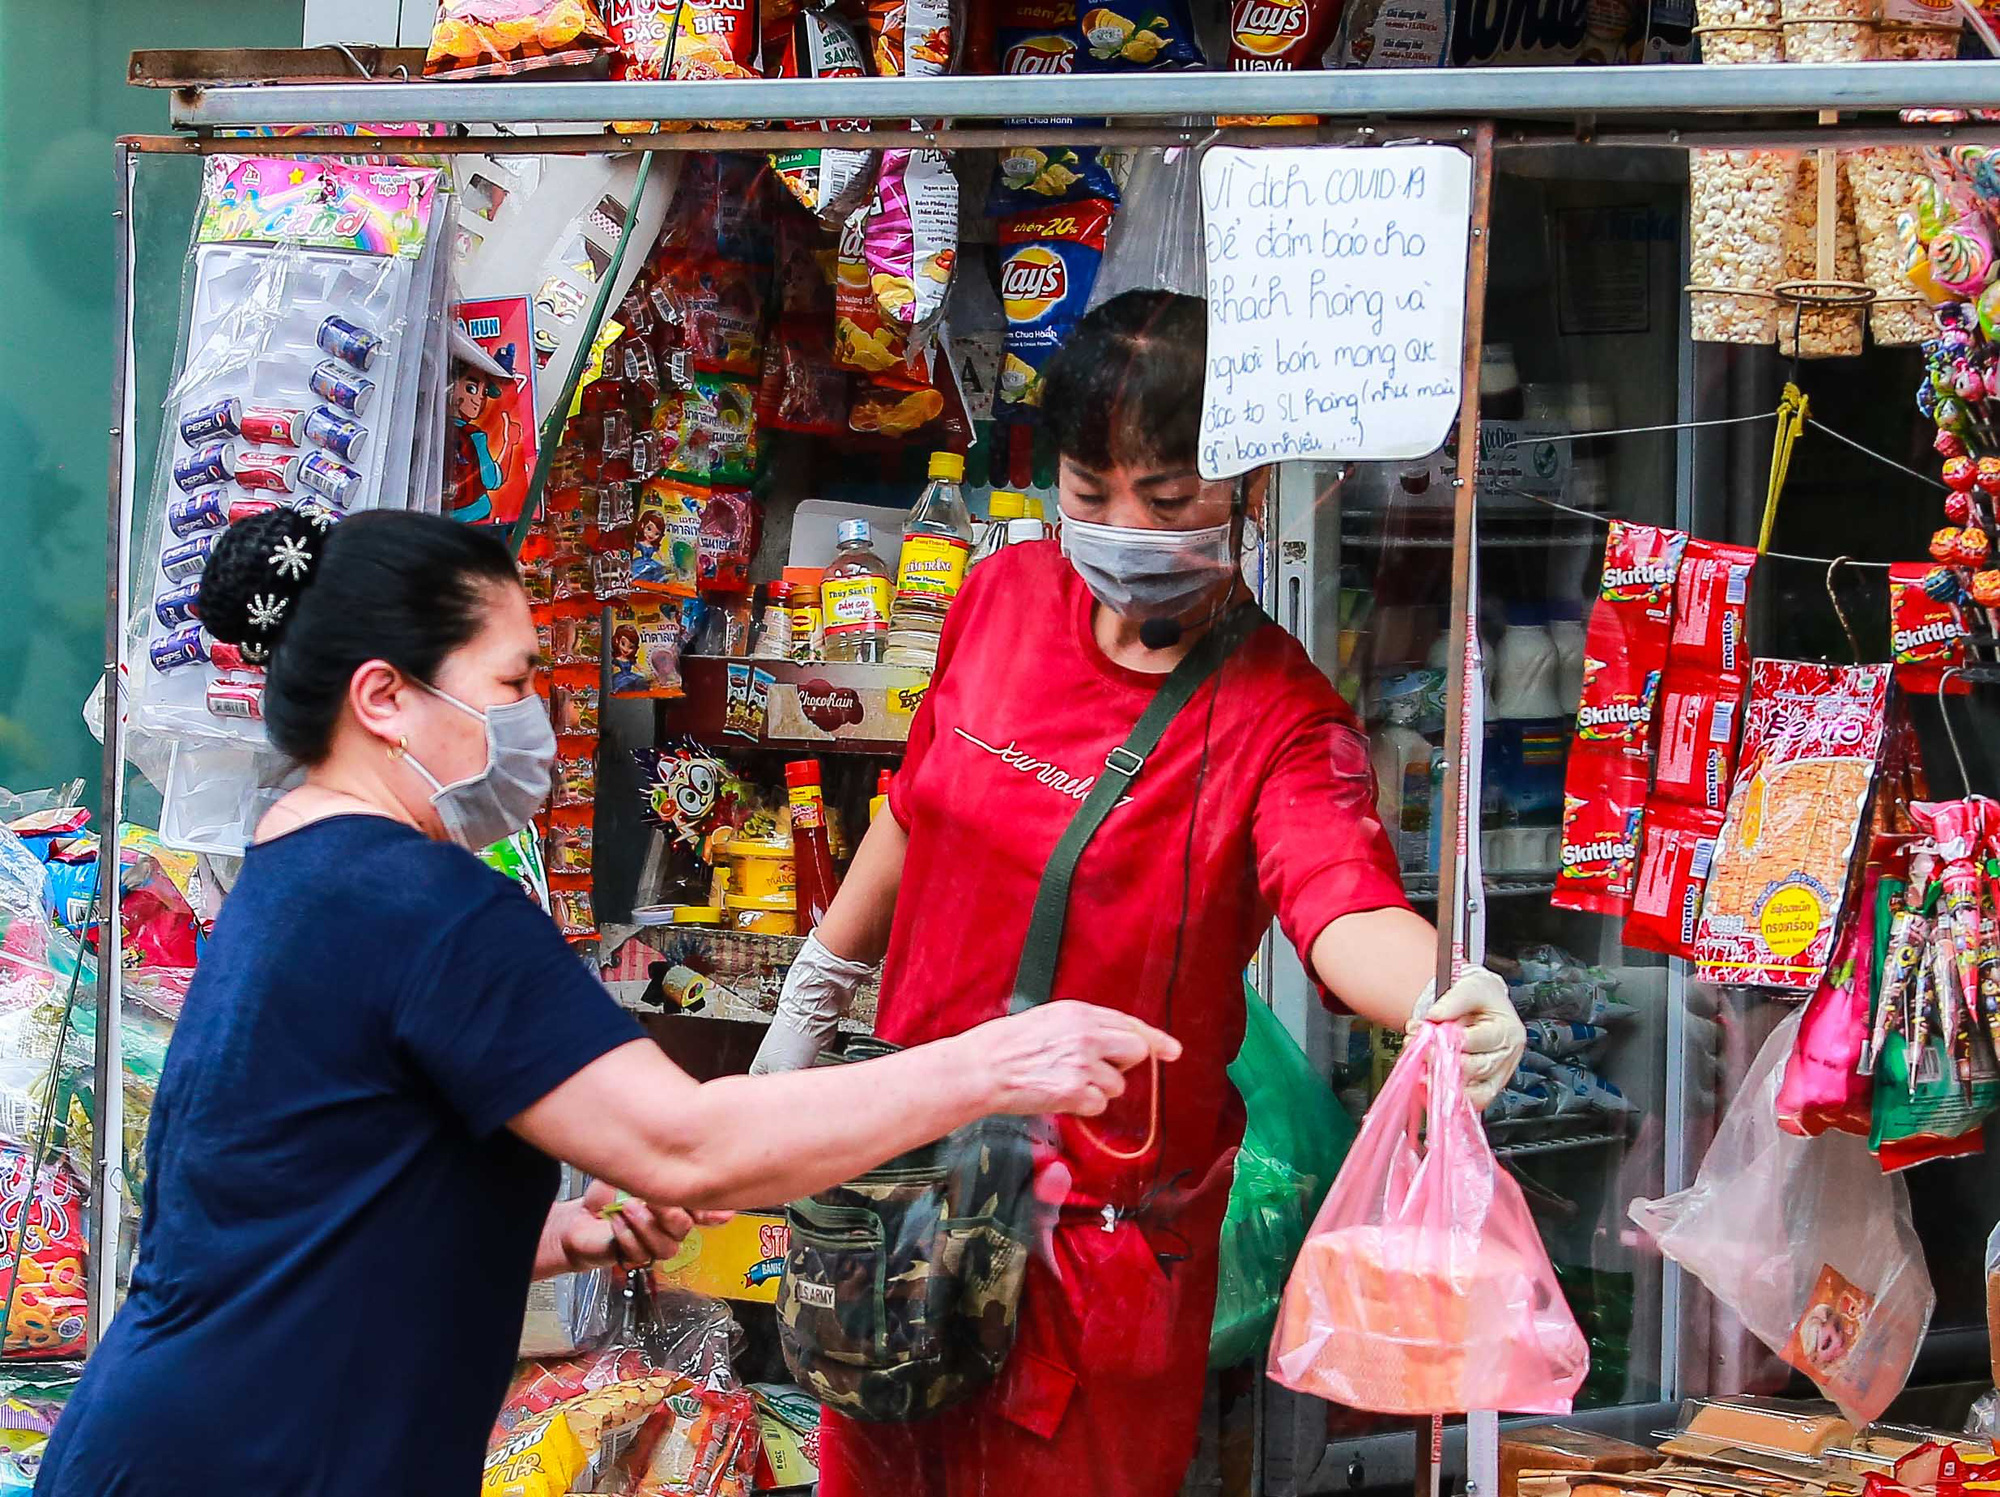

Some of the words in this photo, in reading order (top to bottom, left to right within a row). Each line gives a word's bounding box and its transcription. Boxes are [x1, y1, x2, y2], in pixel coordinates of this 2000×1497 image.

[622, 21, 667, 45] ĐẶC
[692, 12, 737, 36] BIỆT
[1236, 1, 1303, 36] Lay's
[1203, 156, 1256, 211] Vì
[1374, 219, 1426, 257] cho
[1310, 268, 1385, 336] hàng
[470, 318, 499, 337] HUN
[1602, 565, 1677, 588] Skittles
[1722, 610, 1734, 670] mentos
[1894, 622, 1965, 652] Skittles
[1579, 703, 1651, 727] Skittles
[1706, 749, 1718, 807] mentos
[1563, 840, 1636, 866] Skittles
[766, 873, 796, 887] MARG
[1682, 884, 1696, 943] mentos
[809, 1286, 834, 1308] ARMY
